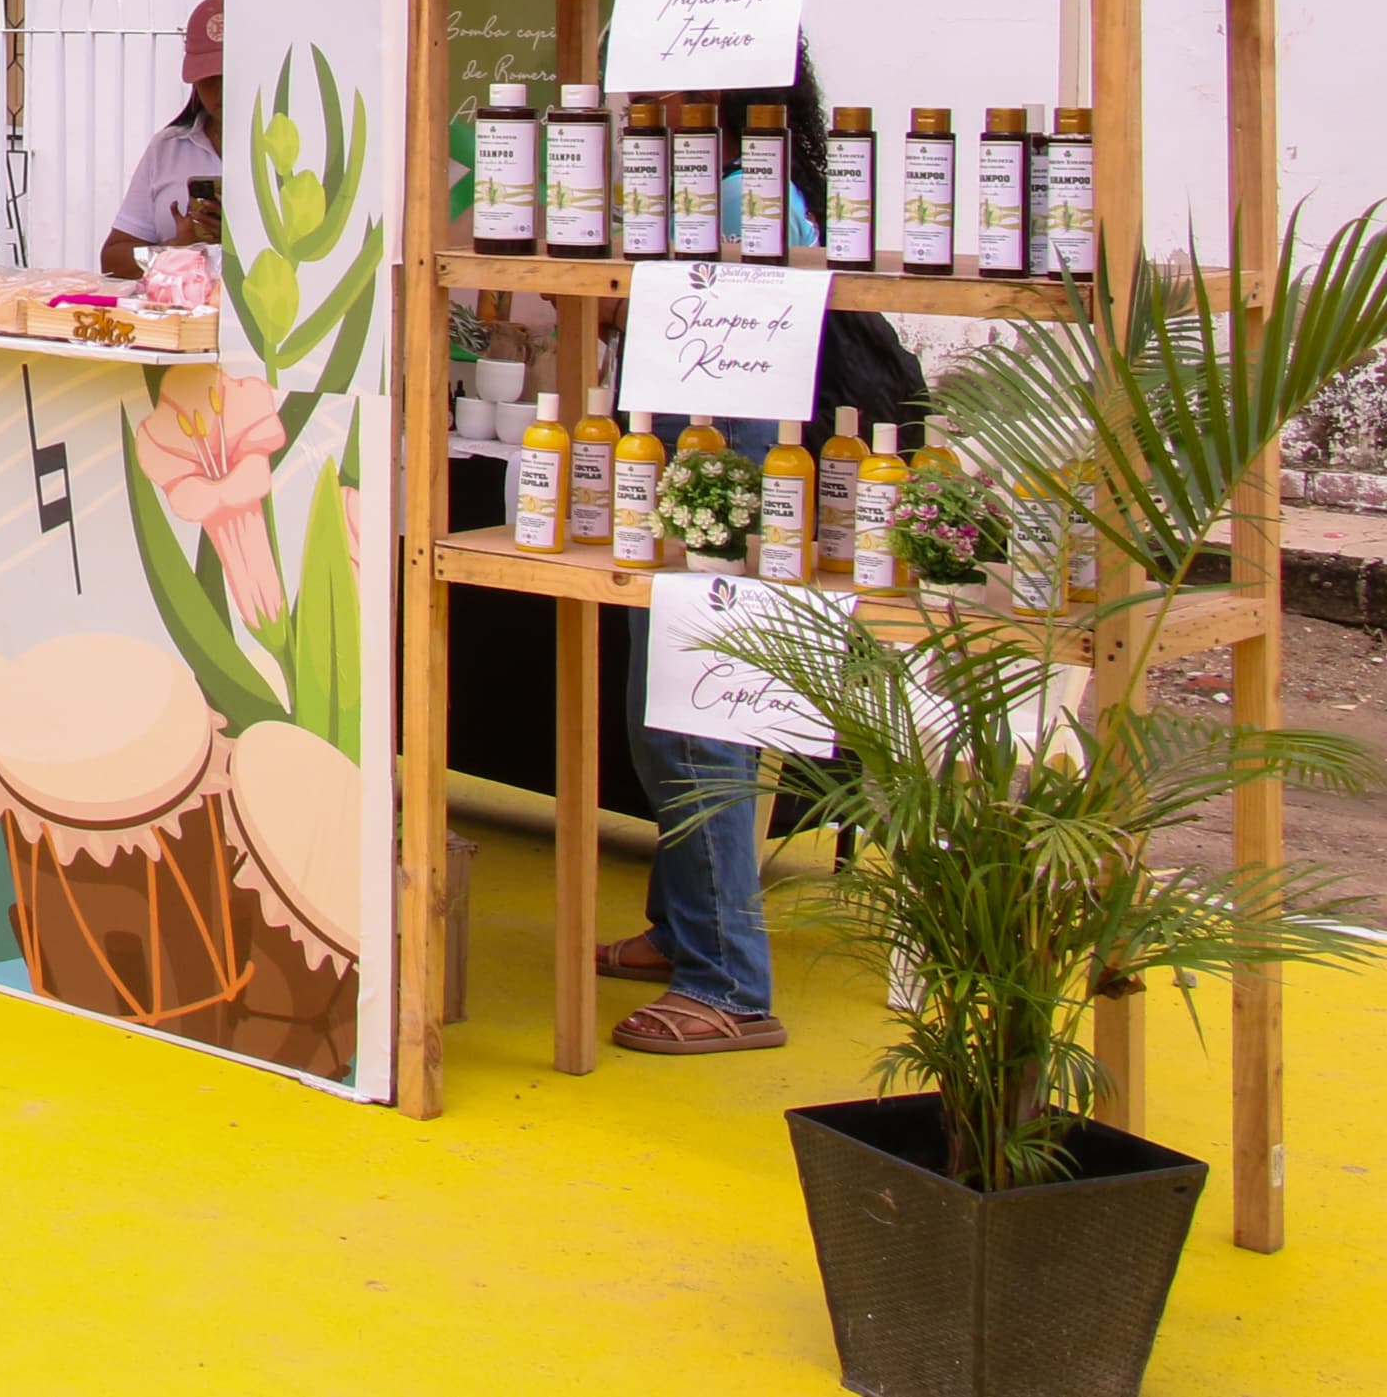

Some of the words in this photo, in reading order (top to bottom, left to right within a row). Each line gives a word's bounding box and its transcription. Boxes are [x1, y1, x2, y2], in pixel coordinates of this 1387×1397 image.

[660, 16, 755, 60] Intensivo
[462, 60, 488, 80] de
[494, 54, 557, 83] Romero
[665, 295, 761, 343] Shampoo
[767, 305, 794, 342] de
[679, 338, 772, 382] Romero
[691, 662, 799, 719] Capilar
